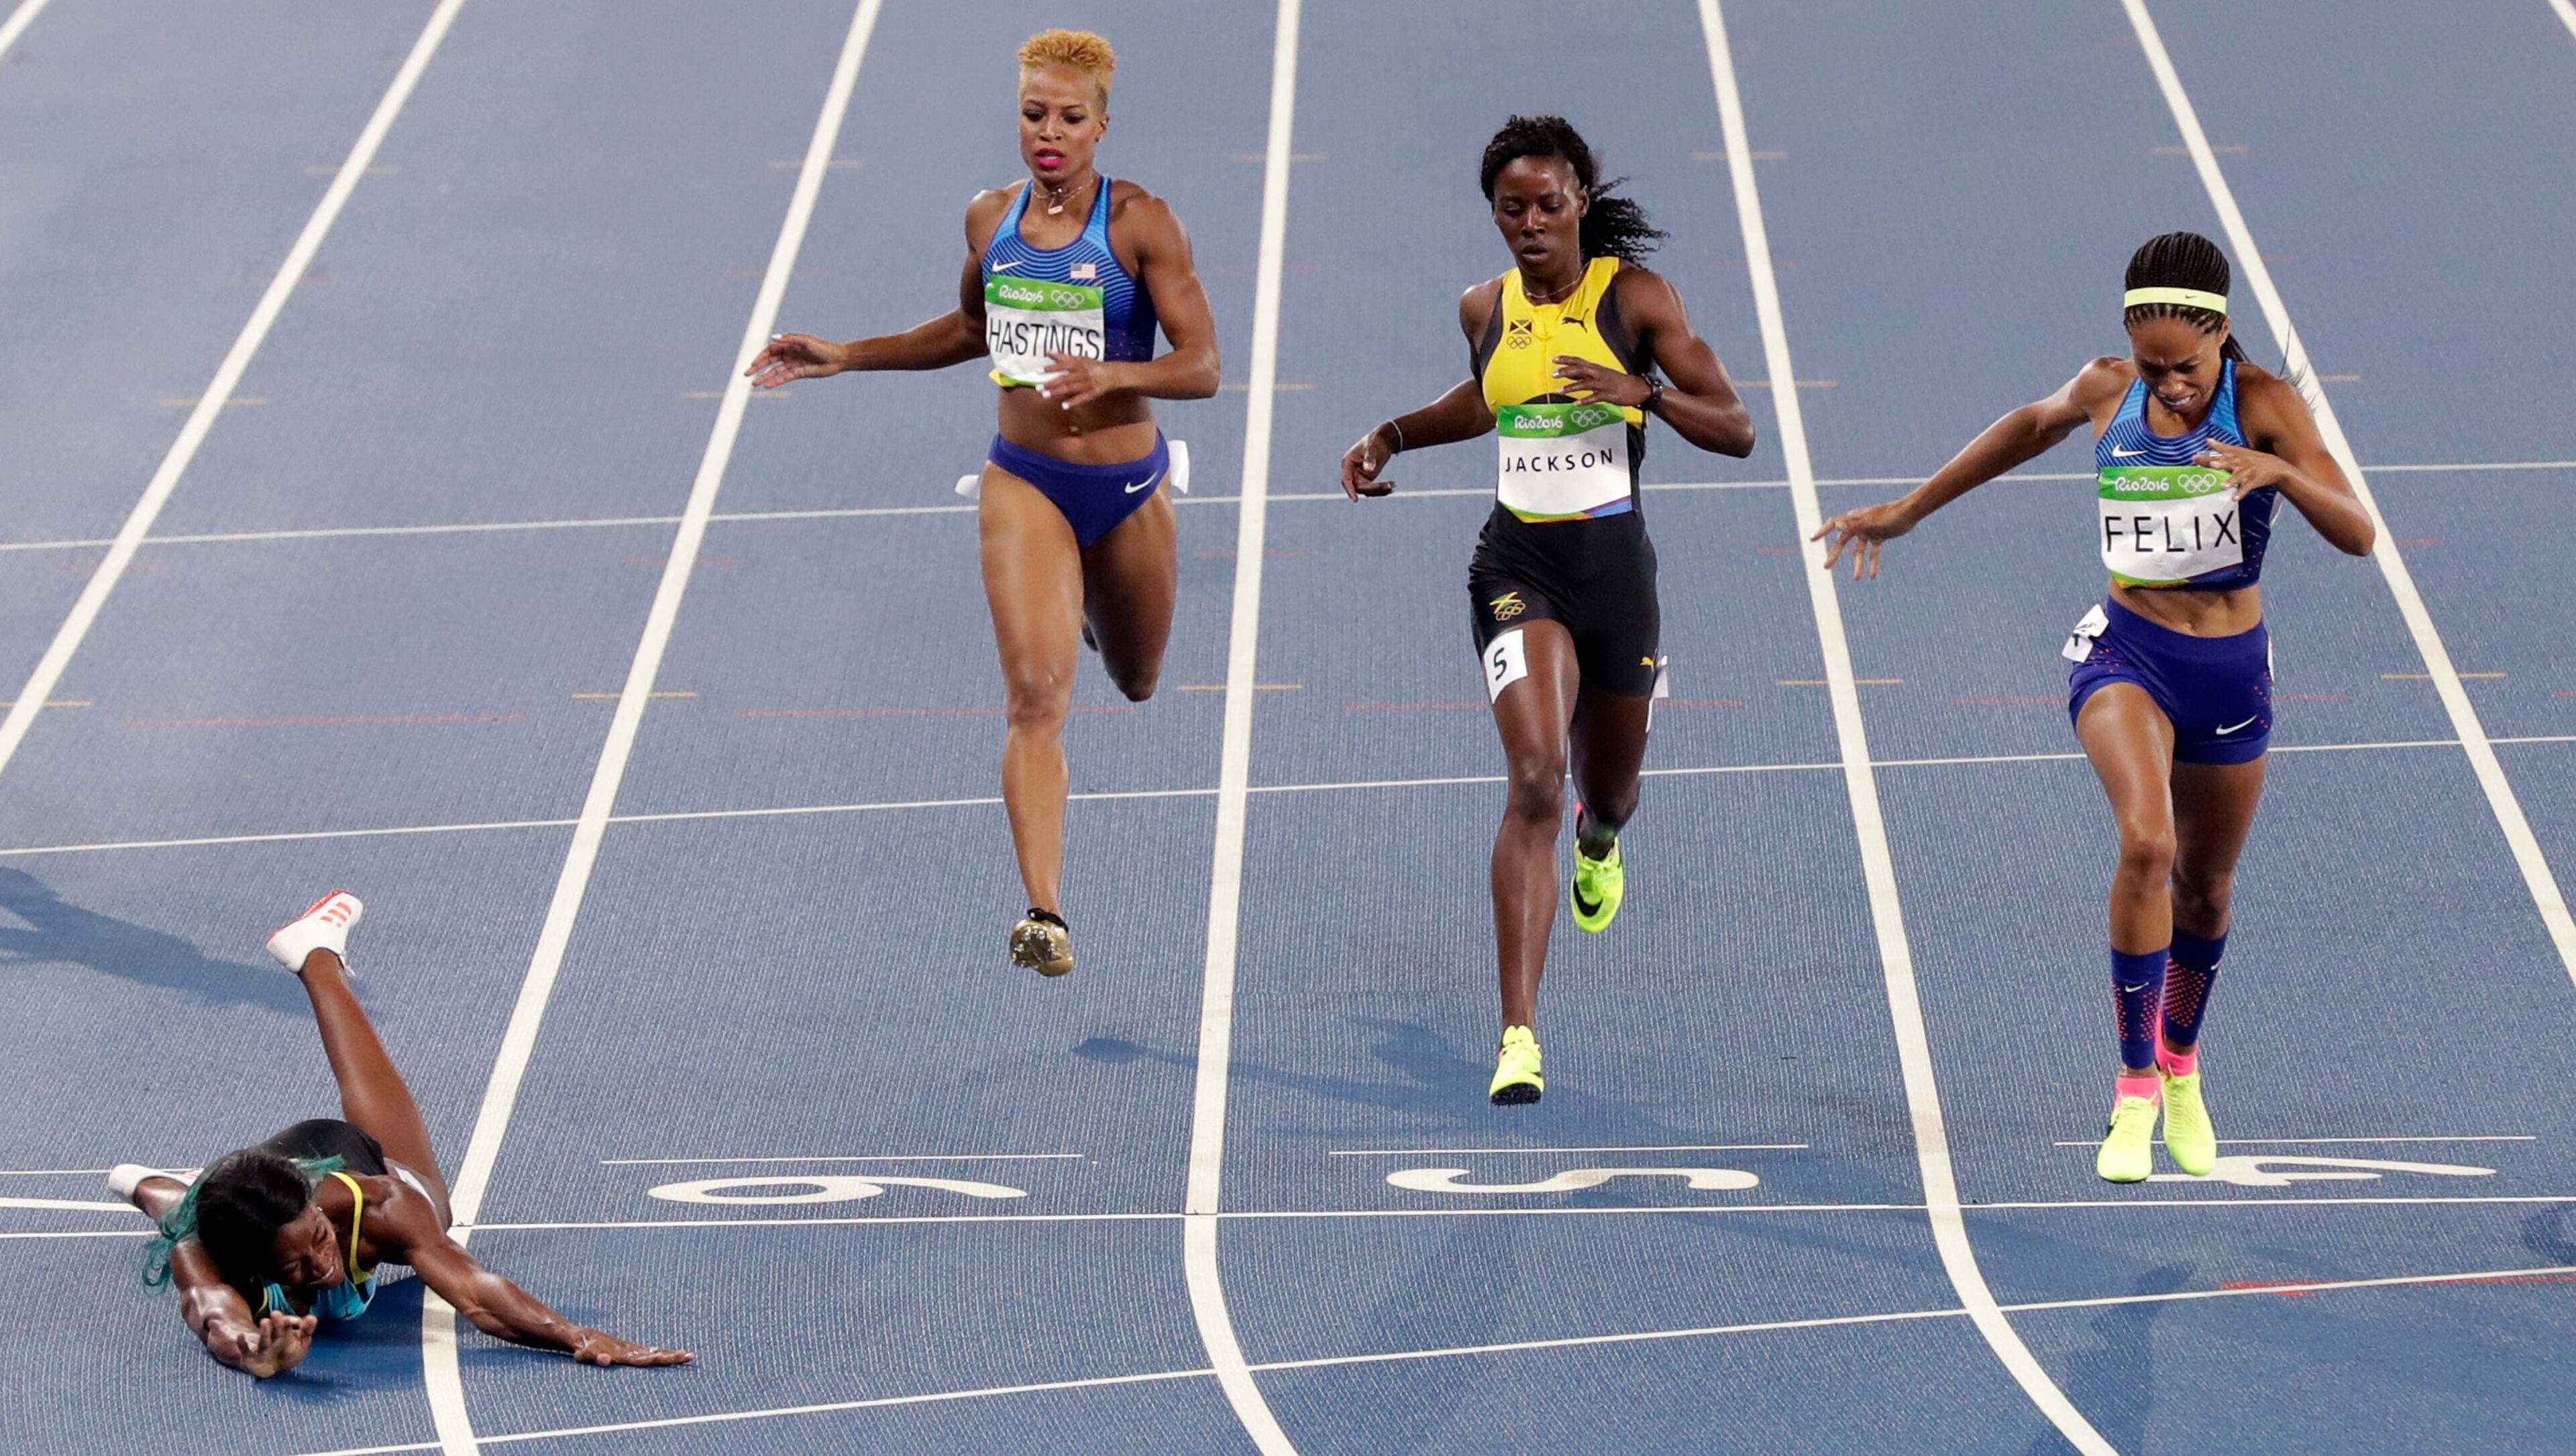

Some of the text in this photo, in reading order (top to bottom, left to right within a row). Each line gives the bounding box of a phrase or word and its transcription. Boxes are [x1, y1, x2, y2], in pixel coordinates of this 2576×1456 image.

[988, 318, 1100, 361] HASTINGS
[1514, 414, 1564, 429] Rio2016
[1505, 449, 1613, 472] JACKSON
[2114, 476, 2170, 492] Rio2016
[2105, 510, 2237, 552] FELIX
[1493, 647, 1507, 681] 5
[1386, 1168, 1760, 1194] 5
